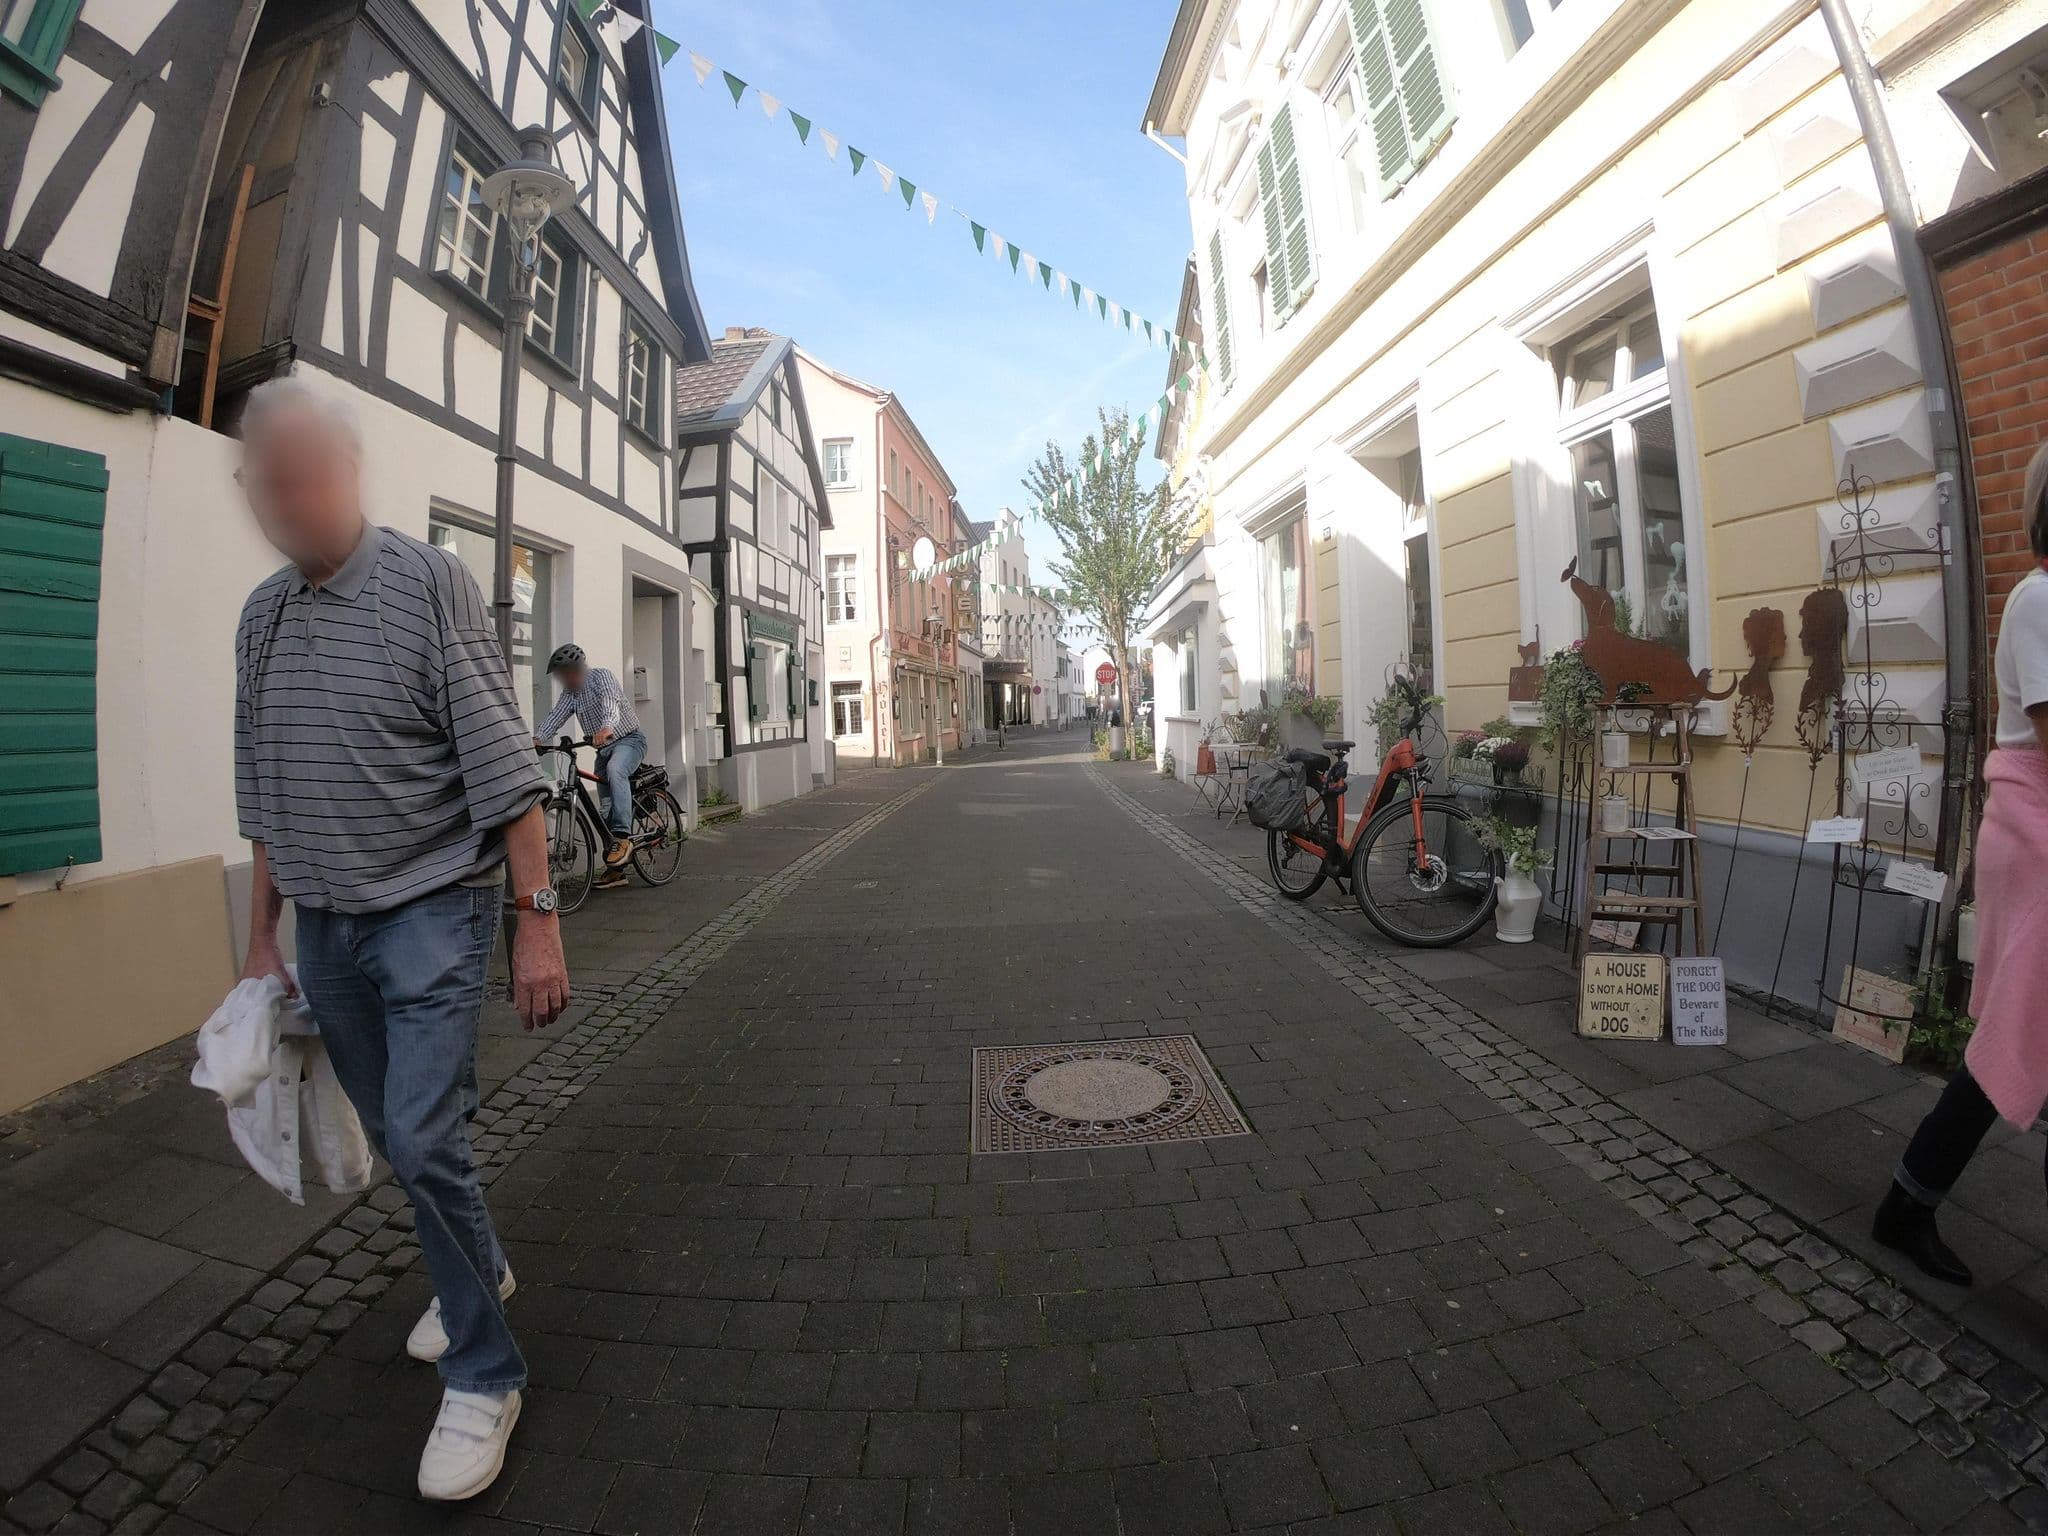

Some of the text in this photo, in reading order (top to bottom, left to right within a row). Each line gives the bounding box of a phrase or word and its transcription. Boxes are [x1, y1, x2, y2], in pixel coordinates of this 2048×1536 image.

[1097, 669, 1115, 679] STOP
[1594, 963, 1647, 977] A HOUSE
[1677, 966, 1717, 977] FORGET
[1587, 983, 1659, 996] IS NOT A HOME
[1676, 982, 1721, 993] THE DOG
[1590, 1001, 1630, 1012] WITHOUT
[1679, 998, 1719, 1009] Beware
[1694, 1011, 1704, 1023] of
[1591, 1016, 1629, 1033] A DOG
[1676, 1026, 1724, 1037] The Kids
